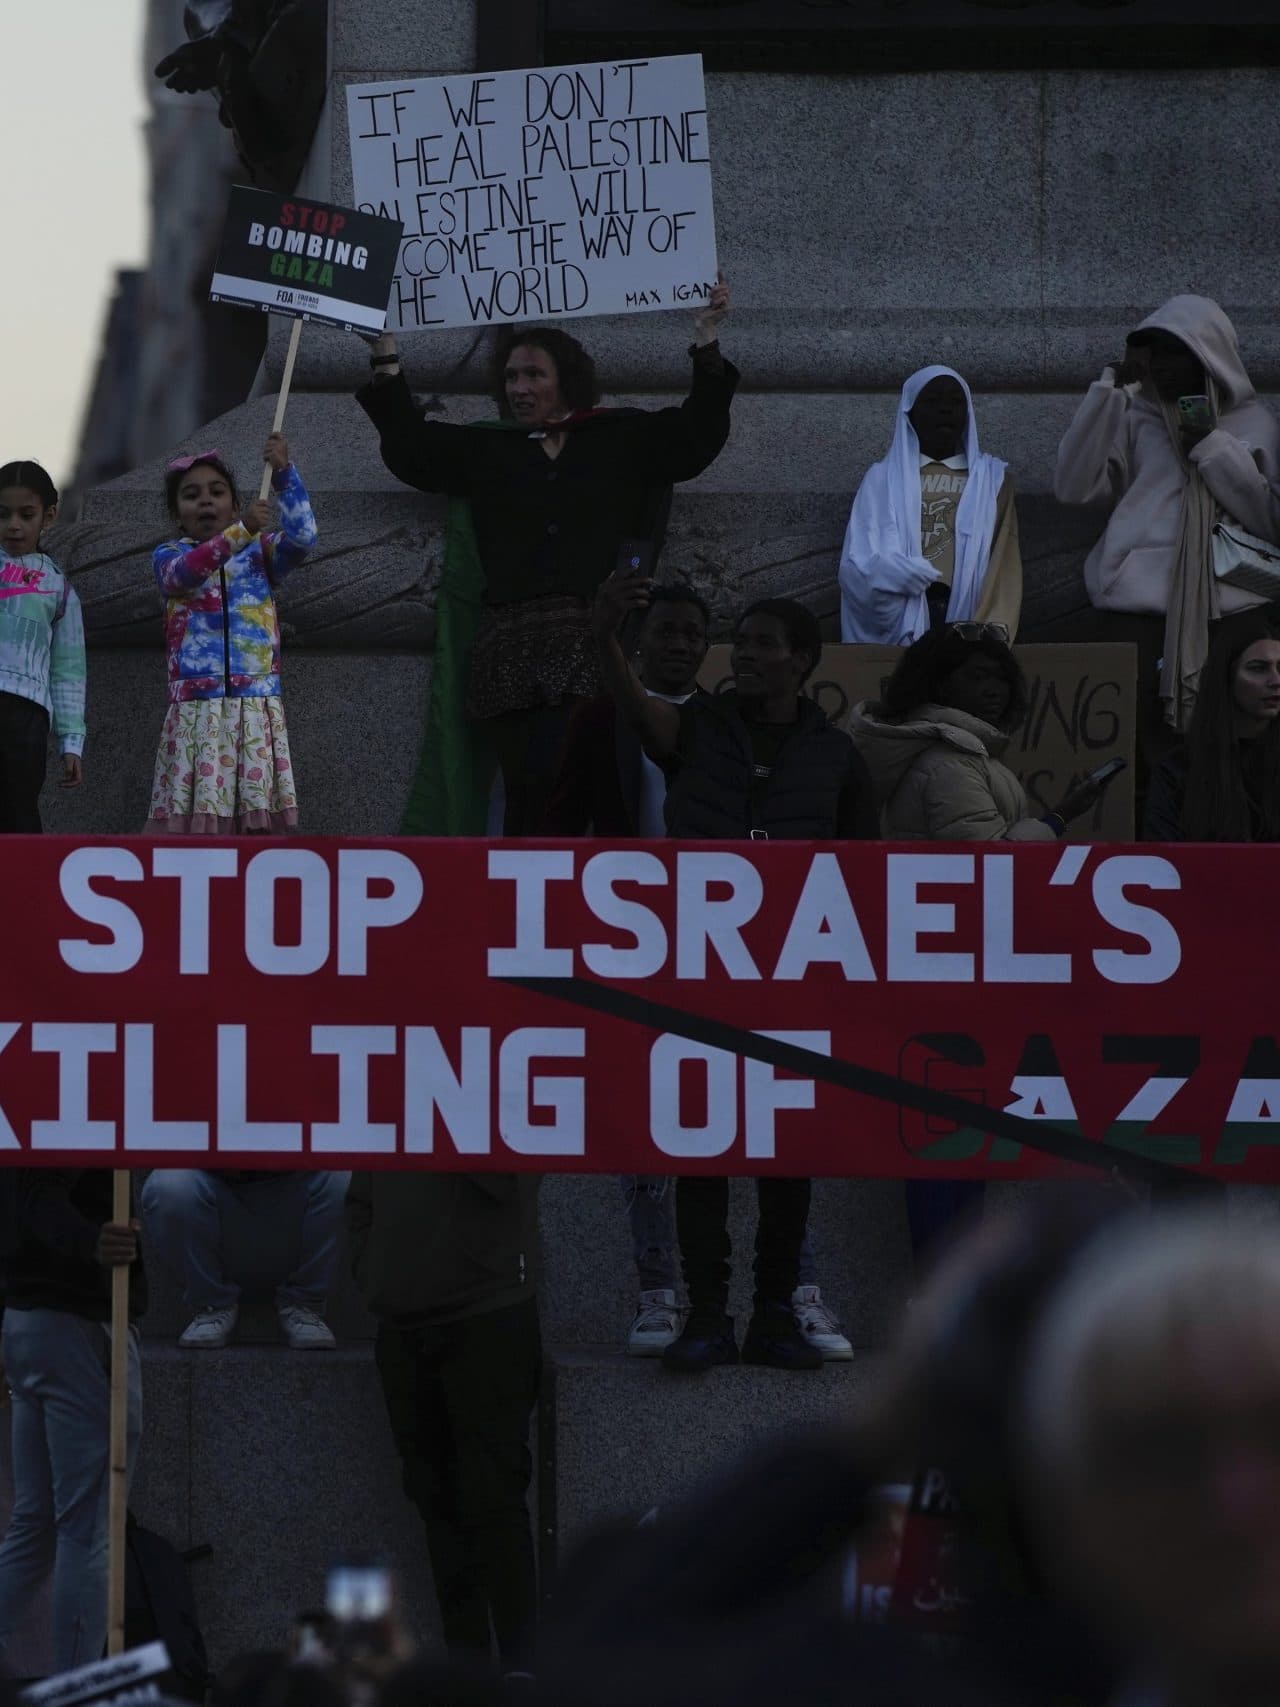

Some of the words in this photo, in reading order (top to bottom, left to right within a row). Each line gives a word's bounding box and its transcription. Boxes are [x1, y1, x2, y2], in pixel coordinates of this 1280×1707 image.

[357, 89, 416, 139] IF
[443, 78, 497, 129] WE
[525, 62, 649, 123] DON'T
[392, 128, 507, 188] HEAL
[521, 110, 711, 175] PALESTINE
[280, 203, 347, 236] STOP
[570, 167, 661, 218] WILL
[248, 222, 369, 270] BOMBING
[270, 253, 334, 288] GAZA
[393, 232, 495, 279] COME
[507, 222, 567, 268] THE
[579, 214, 635, 260] WAY
[647, 211, 696, 254] OF
[275, 289, 295, 305] FOA
[384, 275, 445, 328] HE
[462, 263, 589, 321] WORLD
[625, 287, 662, 308] MAX
[58, 845, 424, 977] STOP
[486, 844, 1183, 985] ISRAEL'S
[649, 1027, 832, 1161] OF
[897, 1031, 1279, 1166] GAZA
